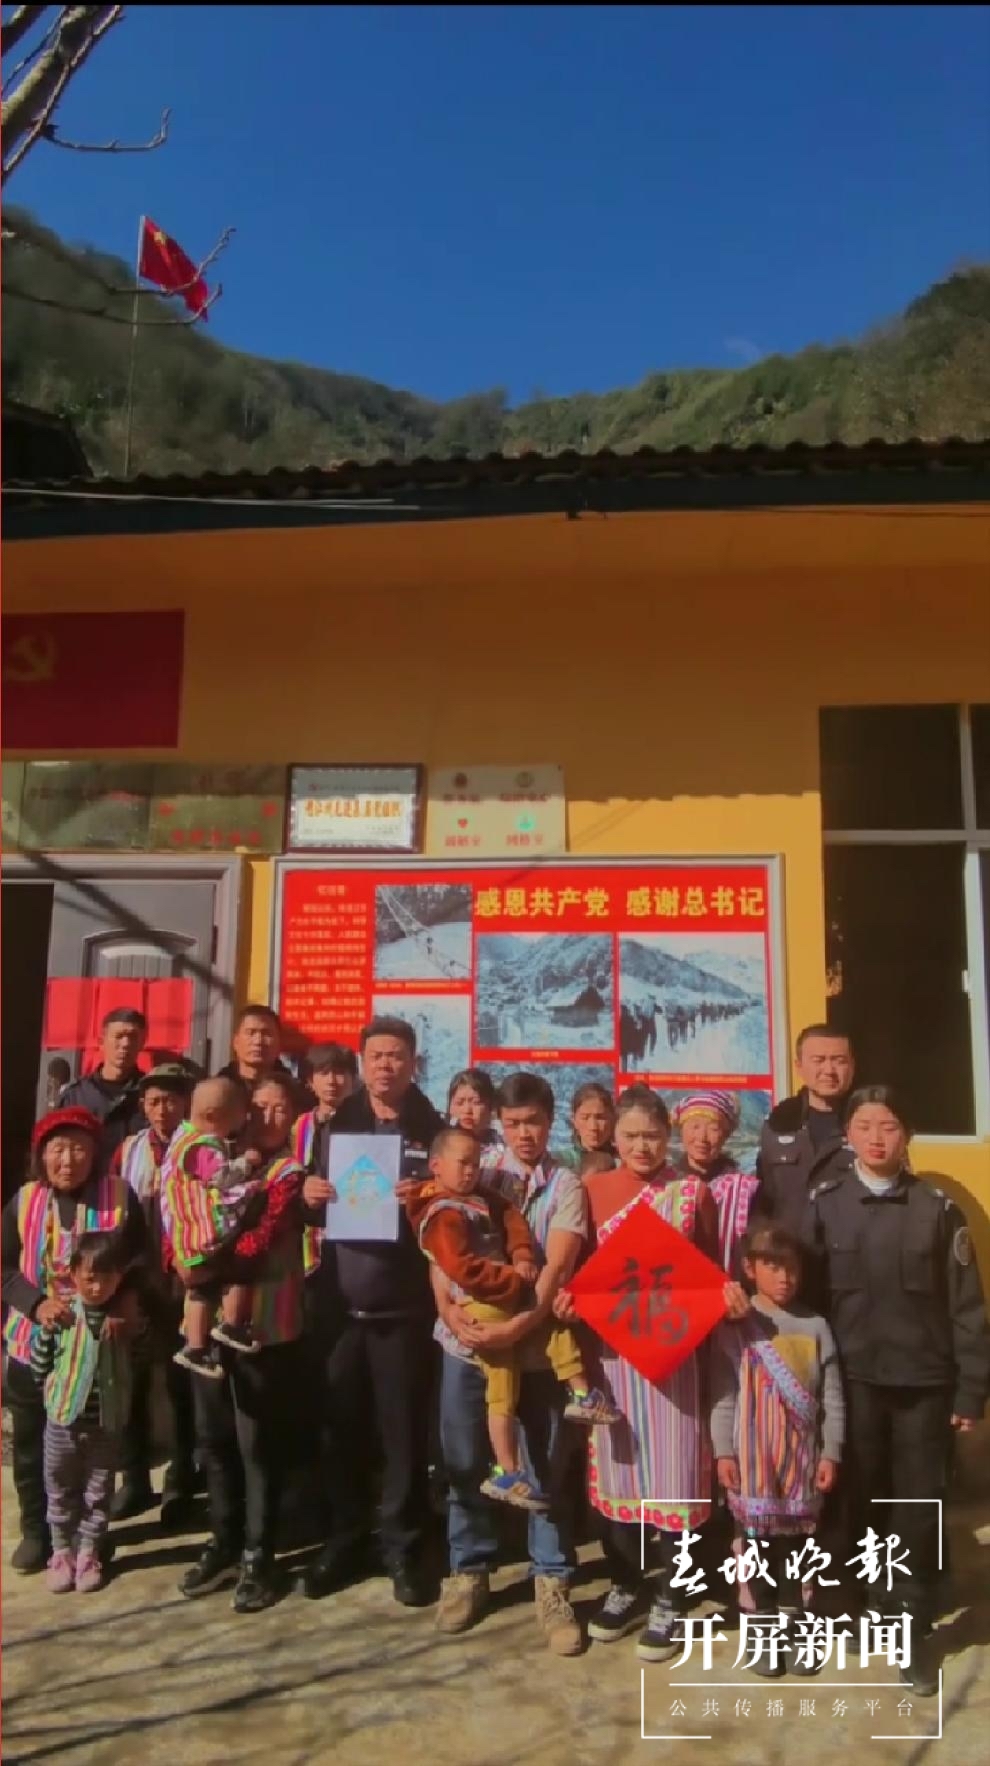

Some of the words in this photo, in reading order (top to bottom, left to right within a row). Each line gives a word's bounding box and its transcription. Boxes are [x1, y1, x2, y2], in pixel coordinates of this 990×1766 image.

[474, 887, 609, 916] 感恩共产党
[626, 887, 765, 916] 感谢总书记
[609, 1257, 689, 1346] 福
